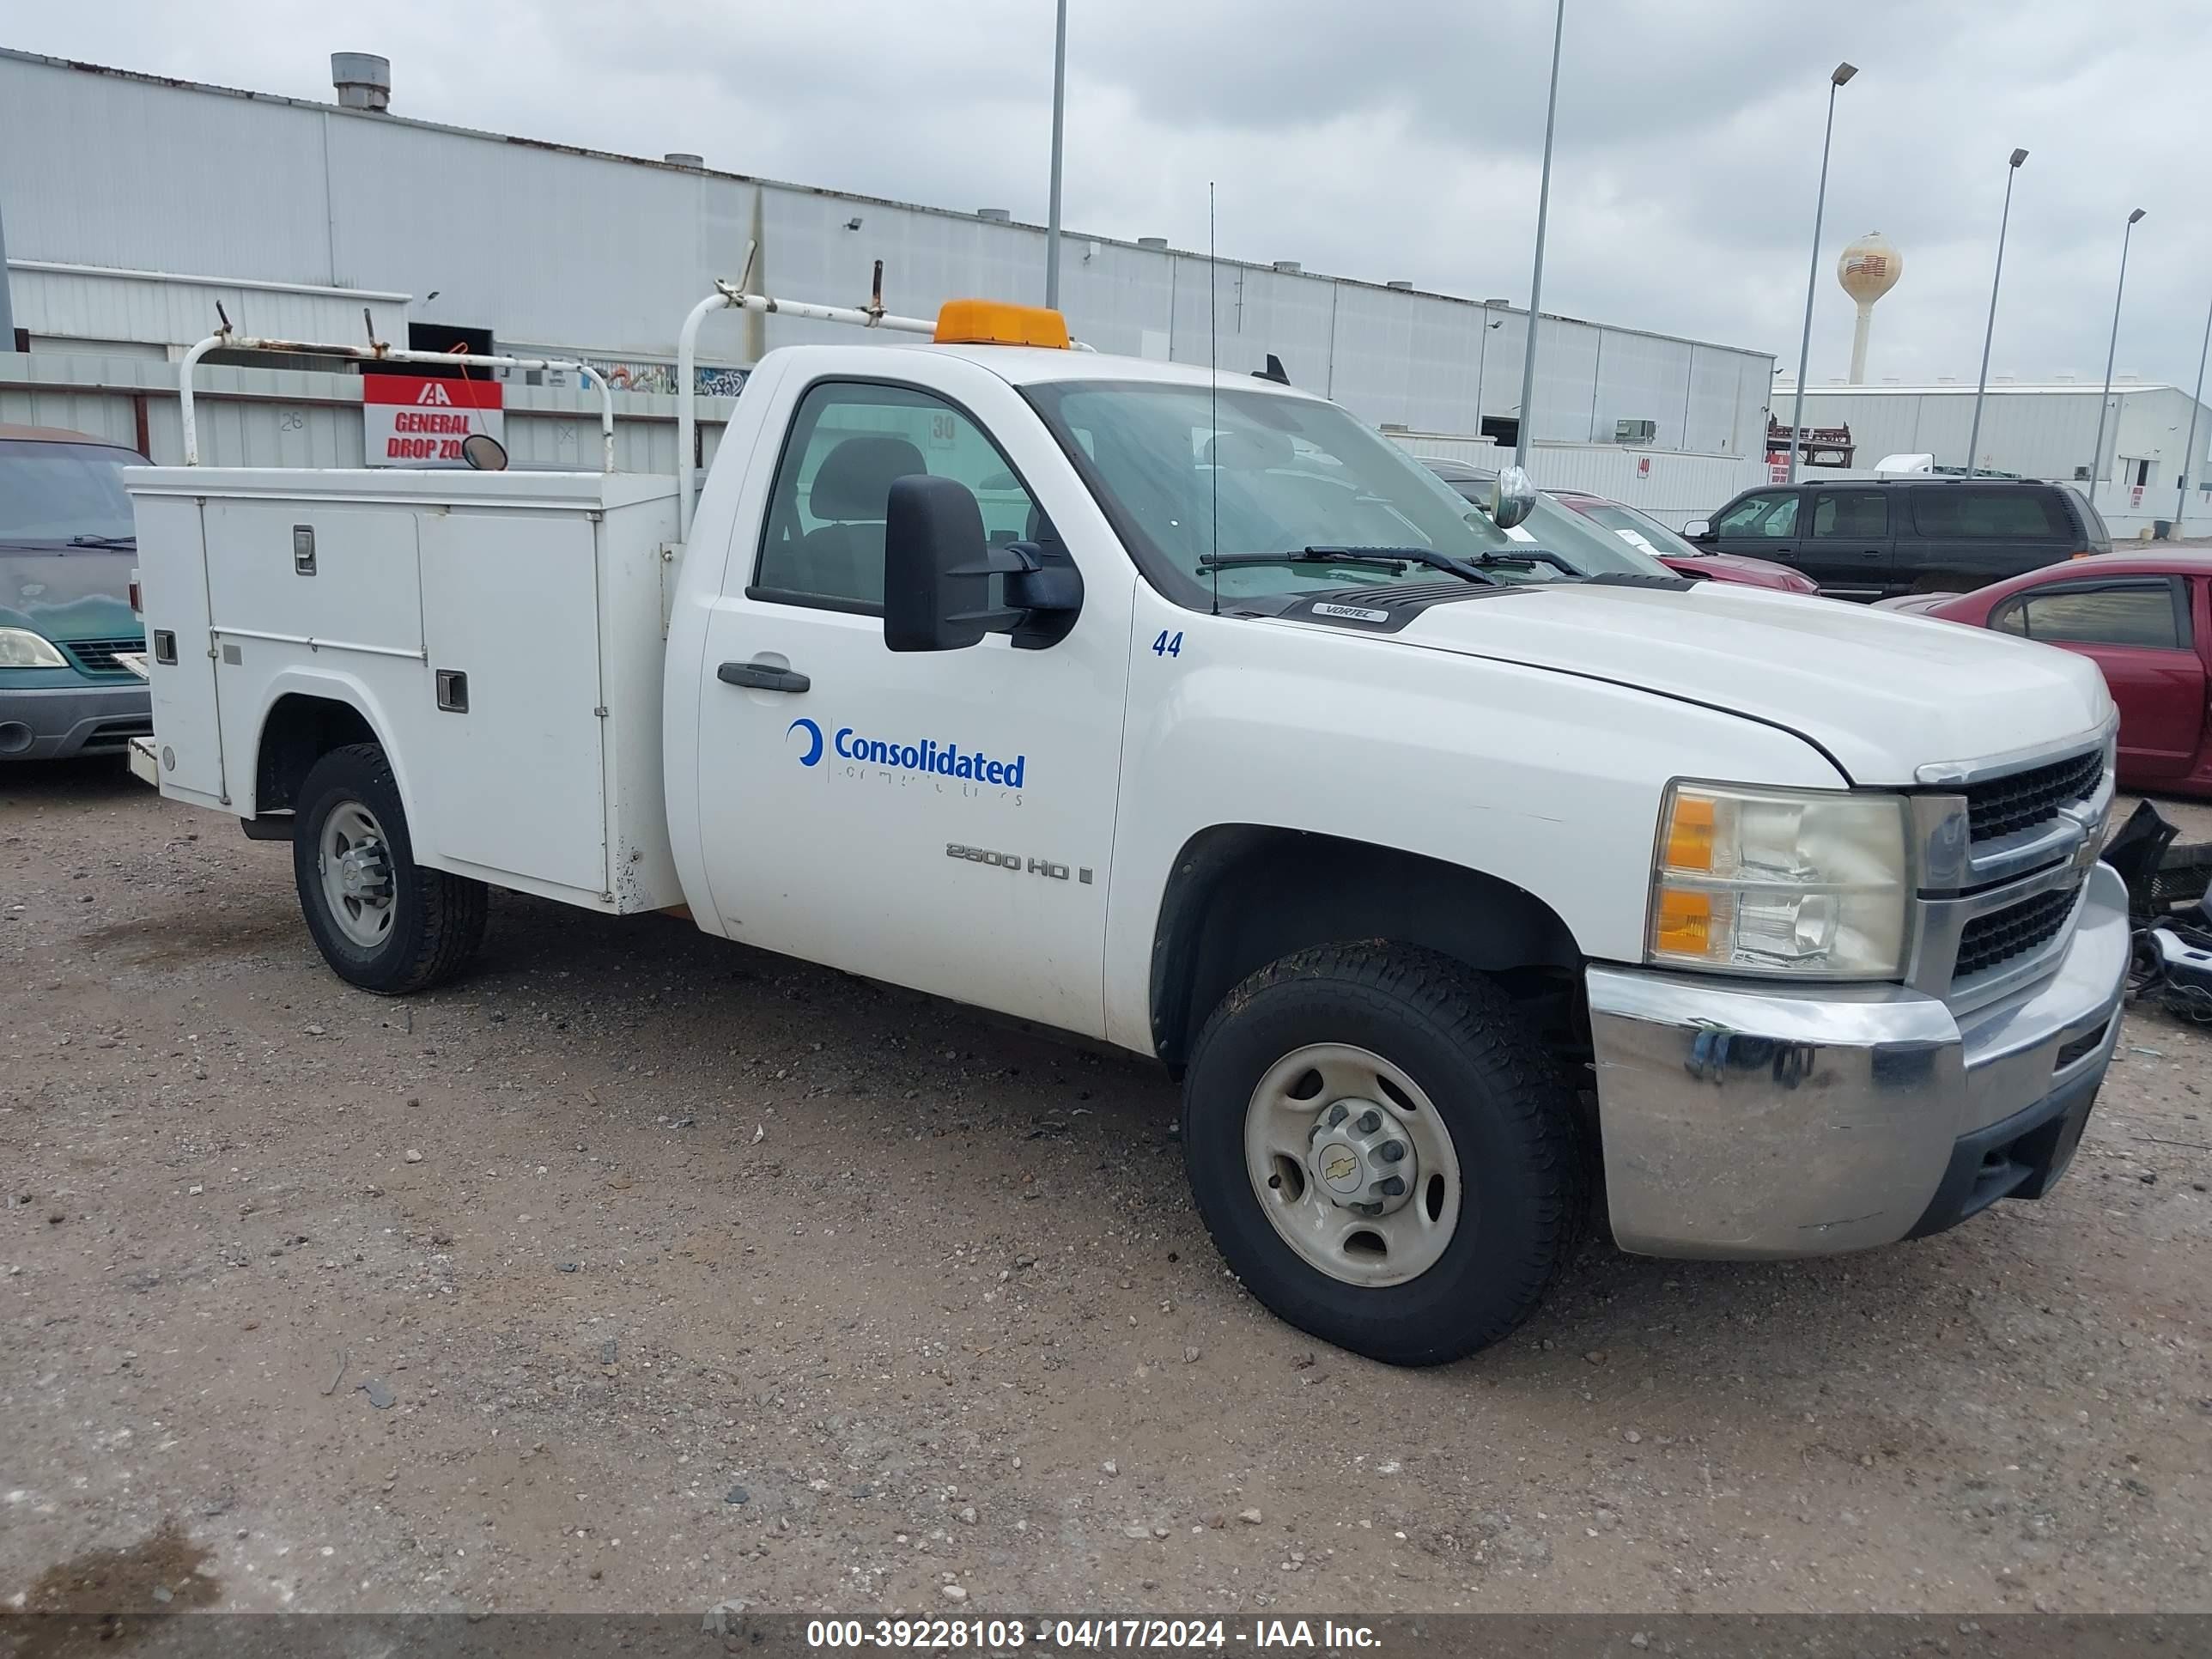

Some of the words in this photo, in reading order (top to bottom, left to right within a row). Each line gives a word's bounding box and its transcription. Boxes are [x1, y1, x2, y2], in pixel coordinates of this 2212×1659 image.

[281, 411, 303, 432] 26
[395, 412, 471, 435] GENERAL
[933, 414, 956, 441] 30
[387, 438, 438, 459] DROP
[1639, 458, 1650, 473] 40
[1325, 605, 1375, 618] VORTEC
[1152, 629, 1184, 658] 44
[835, 727, 1025, 788] Consolidated
[945, 842, 1022, 871] 2500
[1027, 857, 1070, 880] HD
